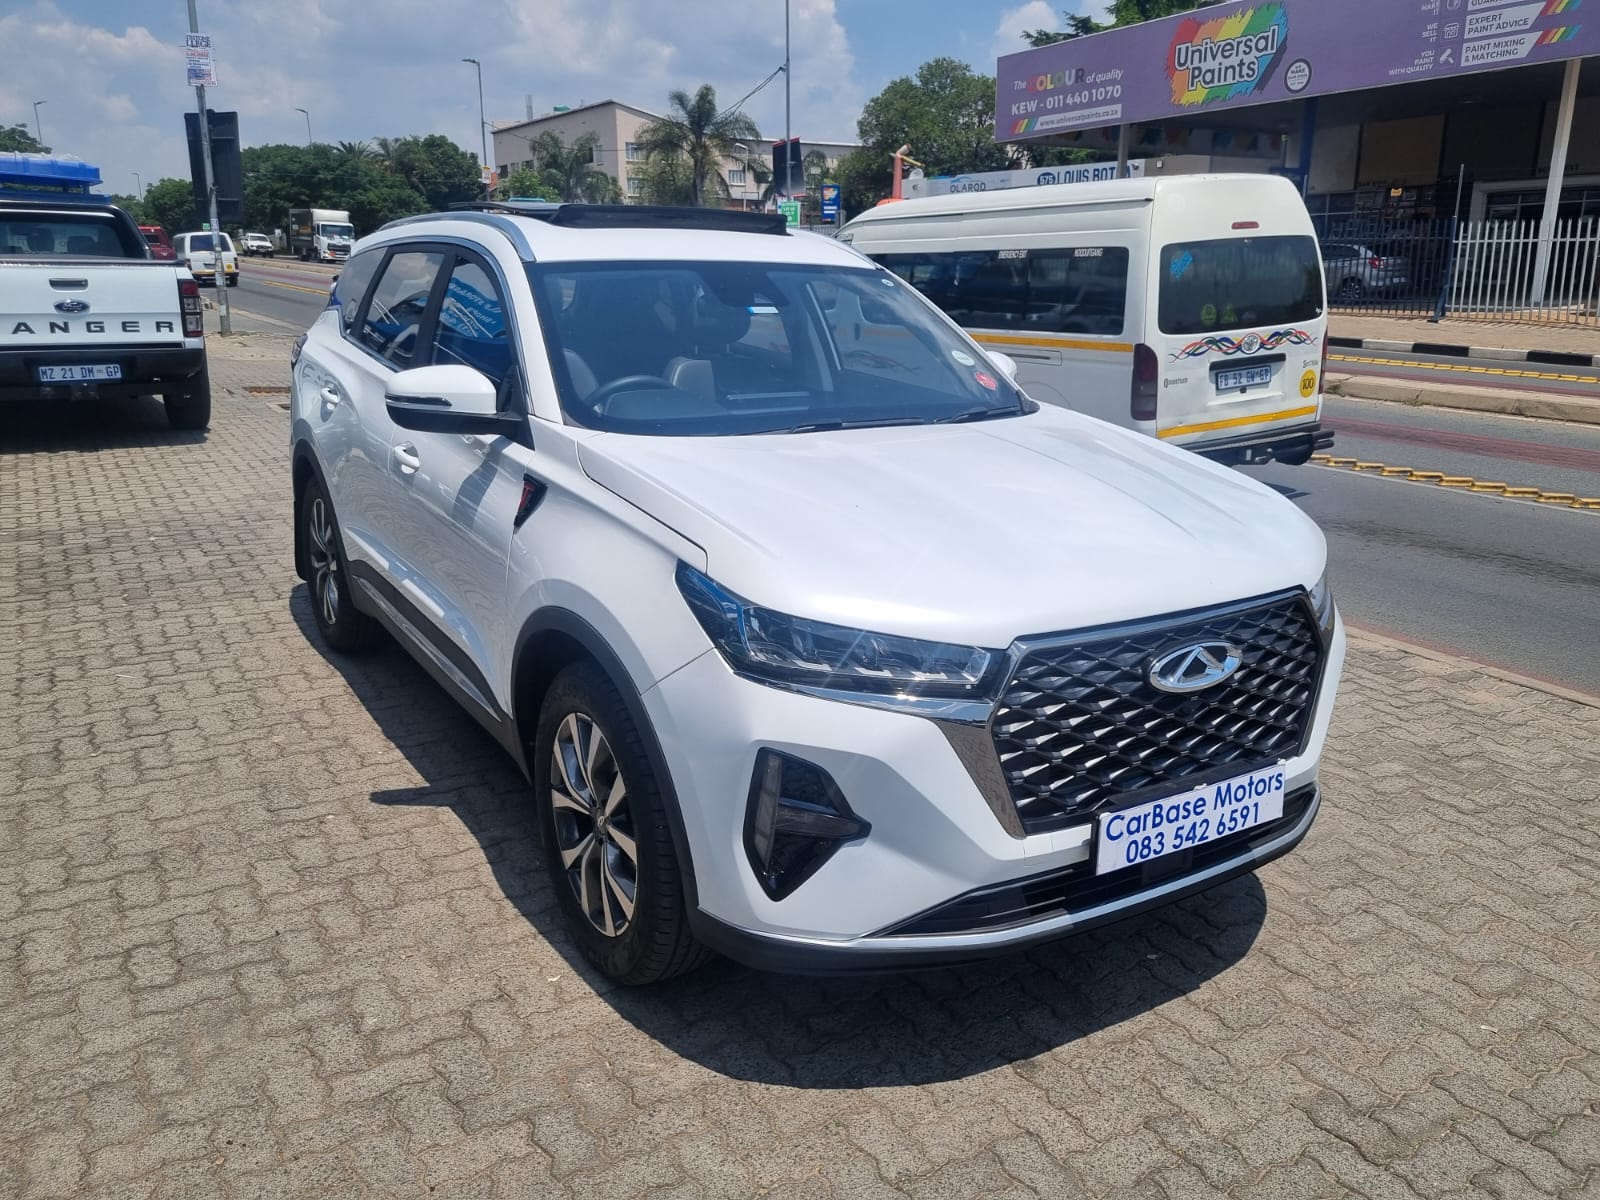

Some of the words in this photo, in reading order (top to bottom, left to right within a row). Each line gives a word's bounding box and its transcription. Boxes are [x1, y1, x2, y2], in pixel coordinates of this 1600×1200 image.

[1467, 24, 1494, 35] PAINT
[1496, 18, 1530, 30] ADVICE
[1469, 14, 1502, 26] EXPERT
[1422, 29, 1437, 38] SELL
[1176, 28, 1276, 68] Universal
[1465, 44, 1492, 54] PAINT
[1492, 37, 1526, 49] MIXING
[1472, 49, 1519, 63] MATCHING
[1190, 58, 1257, 88] Paints
[1389, 68, 1406, 76] WITH
[1406, 64, 1434, 74] QUALITY
[1014, 80, 1026, 90] The
[1027, 68, 1084, 93] COLOUR
[1086, 73, 1095, 83] of
[1096, 69, 1124, 83] quality
[1012, 100, 1038, 116] KEW
[1046, 96, 1063, 109] 011
[1066, 91, 1088, 105] 440
[1092, 85, 1121, 101] 1070
[1039, 175, 1053, 184] 575
[1057, 169, 1089, 184] LOUIS
[1092, 166, 1130, 181] BOTA
[11, 321, 175, 334] ANGER
[40, 368, 54, 379] MZ
[61, 366, 74, 378] 21
[81, 365, 94, 377] DM
[106, 363, 119, 377] GP
[1233, 373, 1242, 384] 52
[1260, 367, 1269, 381] GP
[1302, 378, 1314, 390] 100
[1106, 796, 1206, 841] CarBase
[1213, 772, 1283, 810] Motors
[1126, 832, 1165, 864] 083
[1172, 818, 1210, 850] 542
[1216, 802, 1259, 836] 6591
